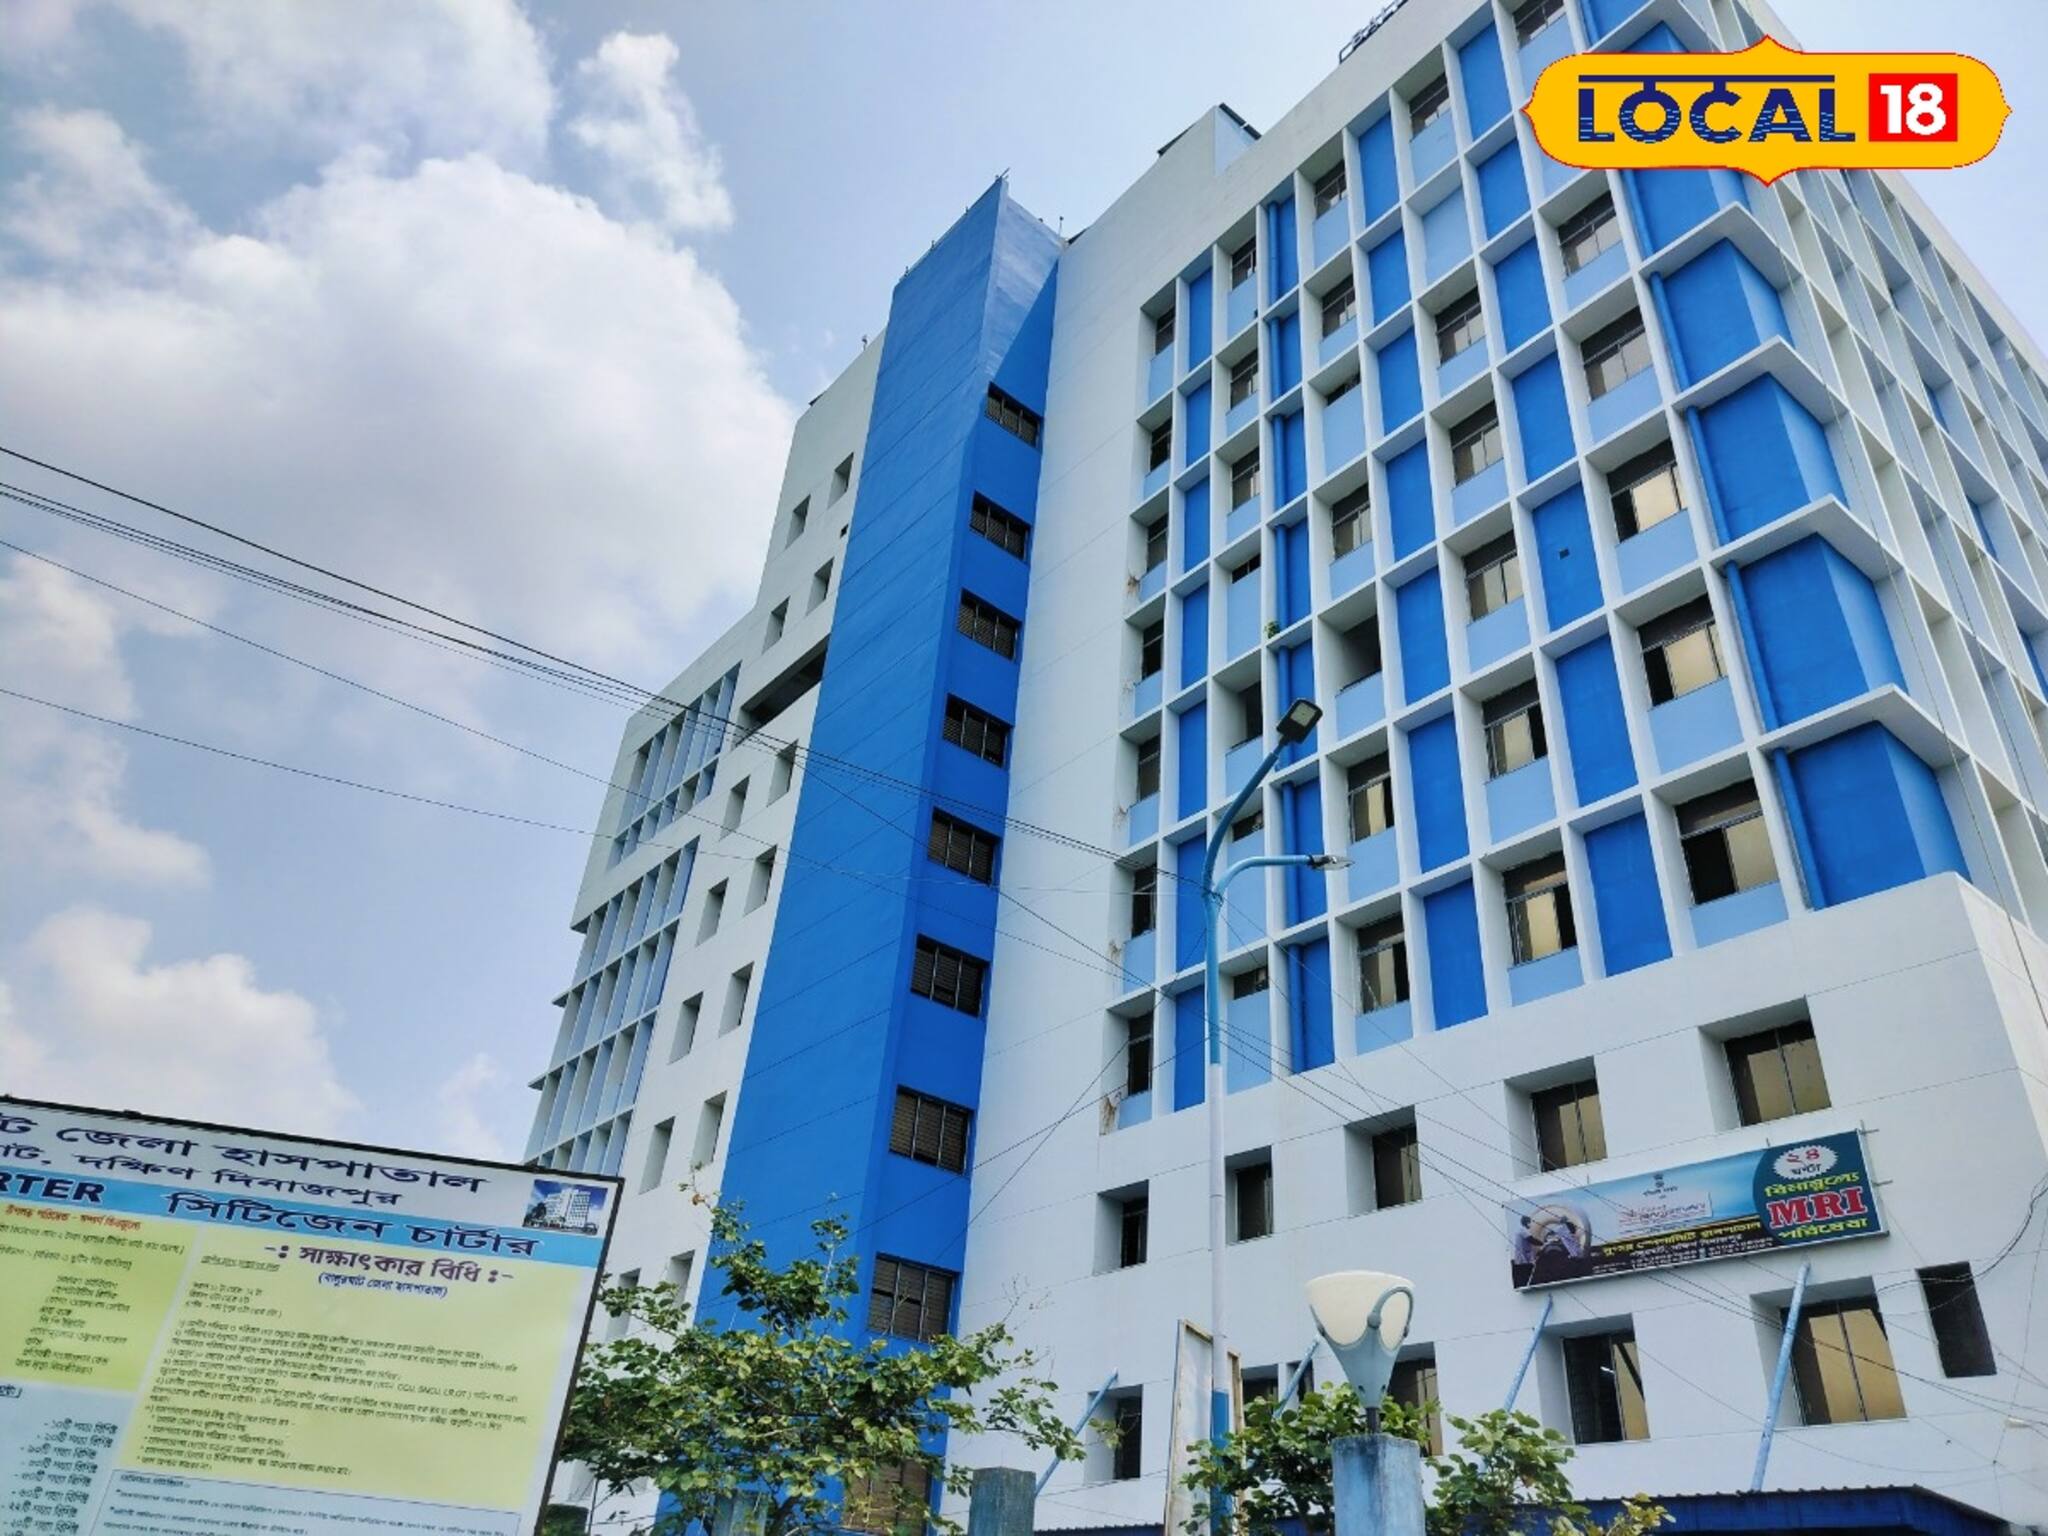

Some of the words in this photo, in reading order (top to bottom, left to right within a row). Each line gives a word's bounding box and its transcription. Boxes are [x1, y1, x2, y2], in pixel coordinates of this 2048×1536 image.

[56, 1127, 200, 1157] জেলা
[212, 1145, 489, 1194] হাসপাতাল
[73, 1154, 201, 1181] দক্ষিণ
[211, 1168, 403, 1208] দিনাজপুর
[1764, 1171, 1861, 1198] বিনামূল্যে
[166, 1191, 393, 1239] সিটিজেন
[406, 1223, 542, 1257] চার্টার
[1766, 1185, 1869, 1229] MRI
[1778, 1216, 1869, 1239] পরিষেবা
[299, 1244, 426, 1279] সাক্ষাৎকার
[430, 1256, 482, 1284] বিধি
[367, 1276, 393, 1290] জেলা
[394, 1280, 449, 1300] হাসপাতাল)
